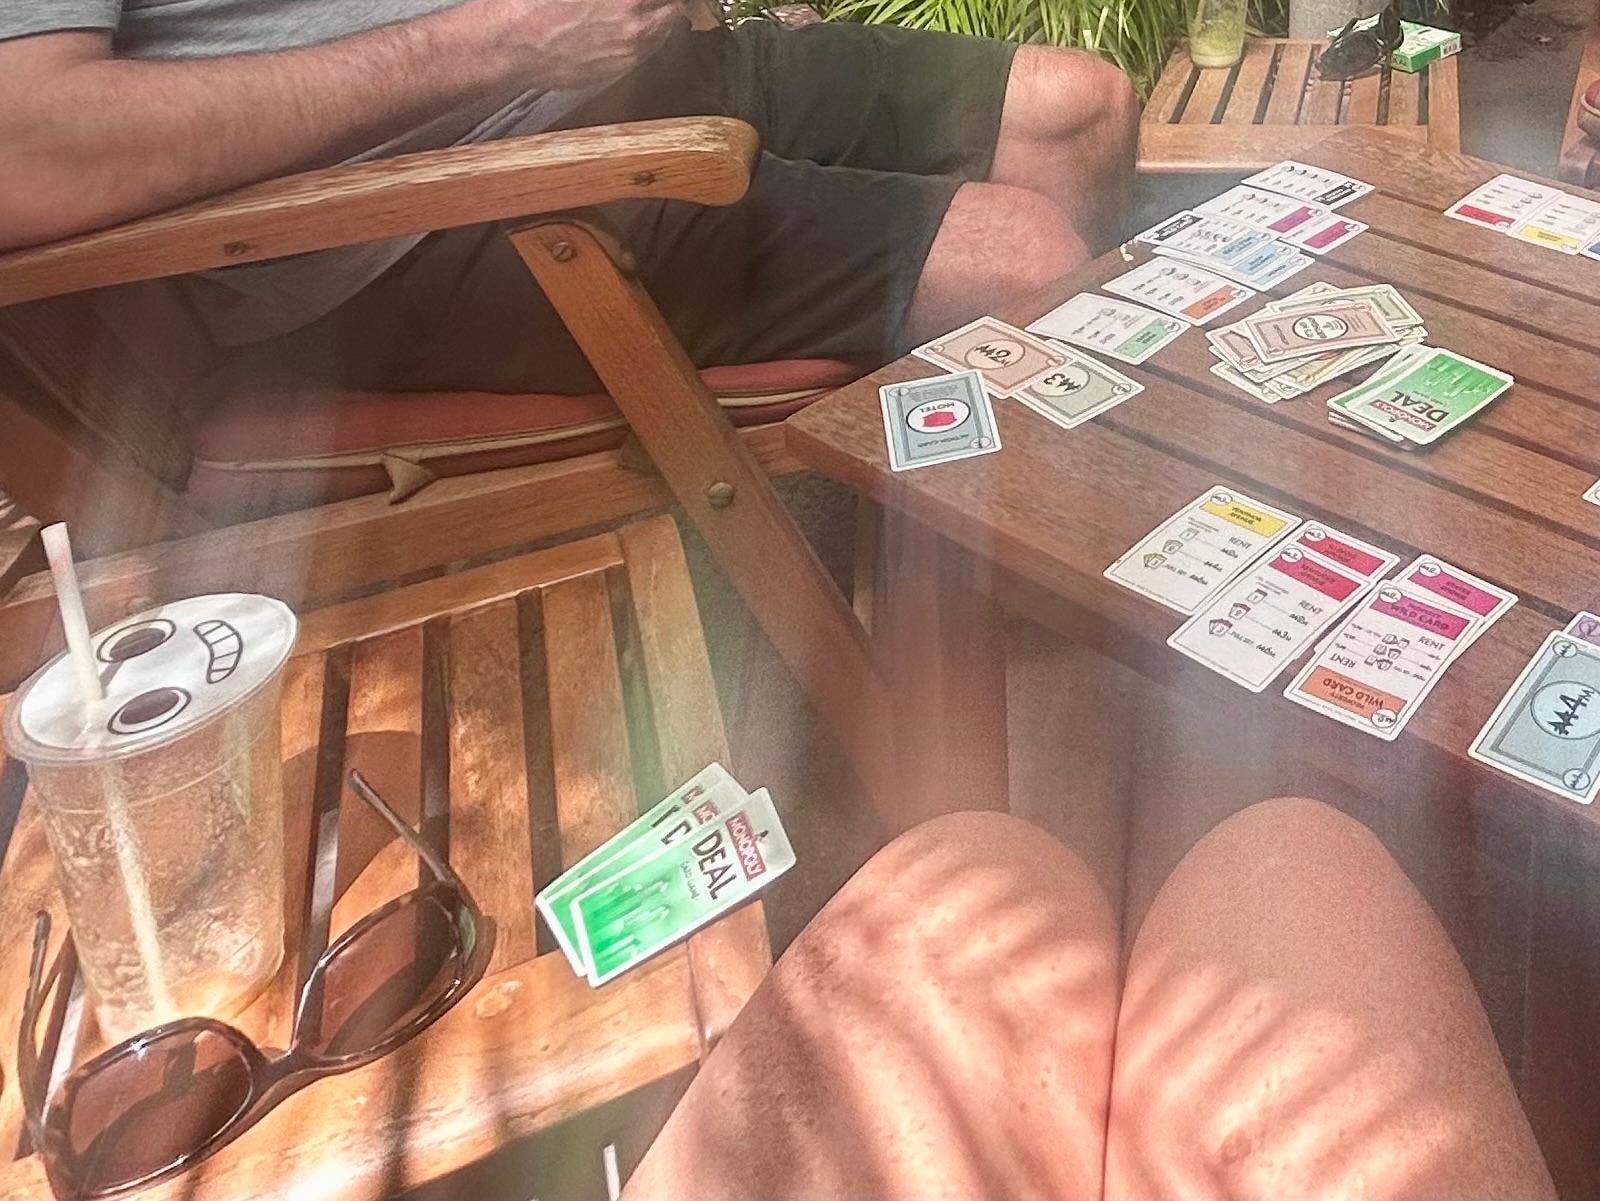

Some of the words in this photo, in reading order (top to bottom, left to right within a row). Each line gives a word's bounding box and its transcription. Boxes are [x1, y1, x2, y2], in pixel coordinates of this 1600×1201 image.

[920, 402, 955, 413] HOTEL
[1392, 390, 1449, 422] DEAL
[1375, 402, 1436, 431] MONOPOLY
[1225, 536, 1254, 549] RENT
[1295, 599, 1325, 615] RENT
[1415, 613, 1449, 631] CARD
[1417, 635, 1446, 651] RENT
[1328, 652, 1357, 668] RENT
[1319, 677, 1354, 696] CARD
[1353, 690, 1386, 709] WILD
[732, 817, 763, 874] MONOPOLY
[692, 829, 737, 900] DEAL
